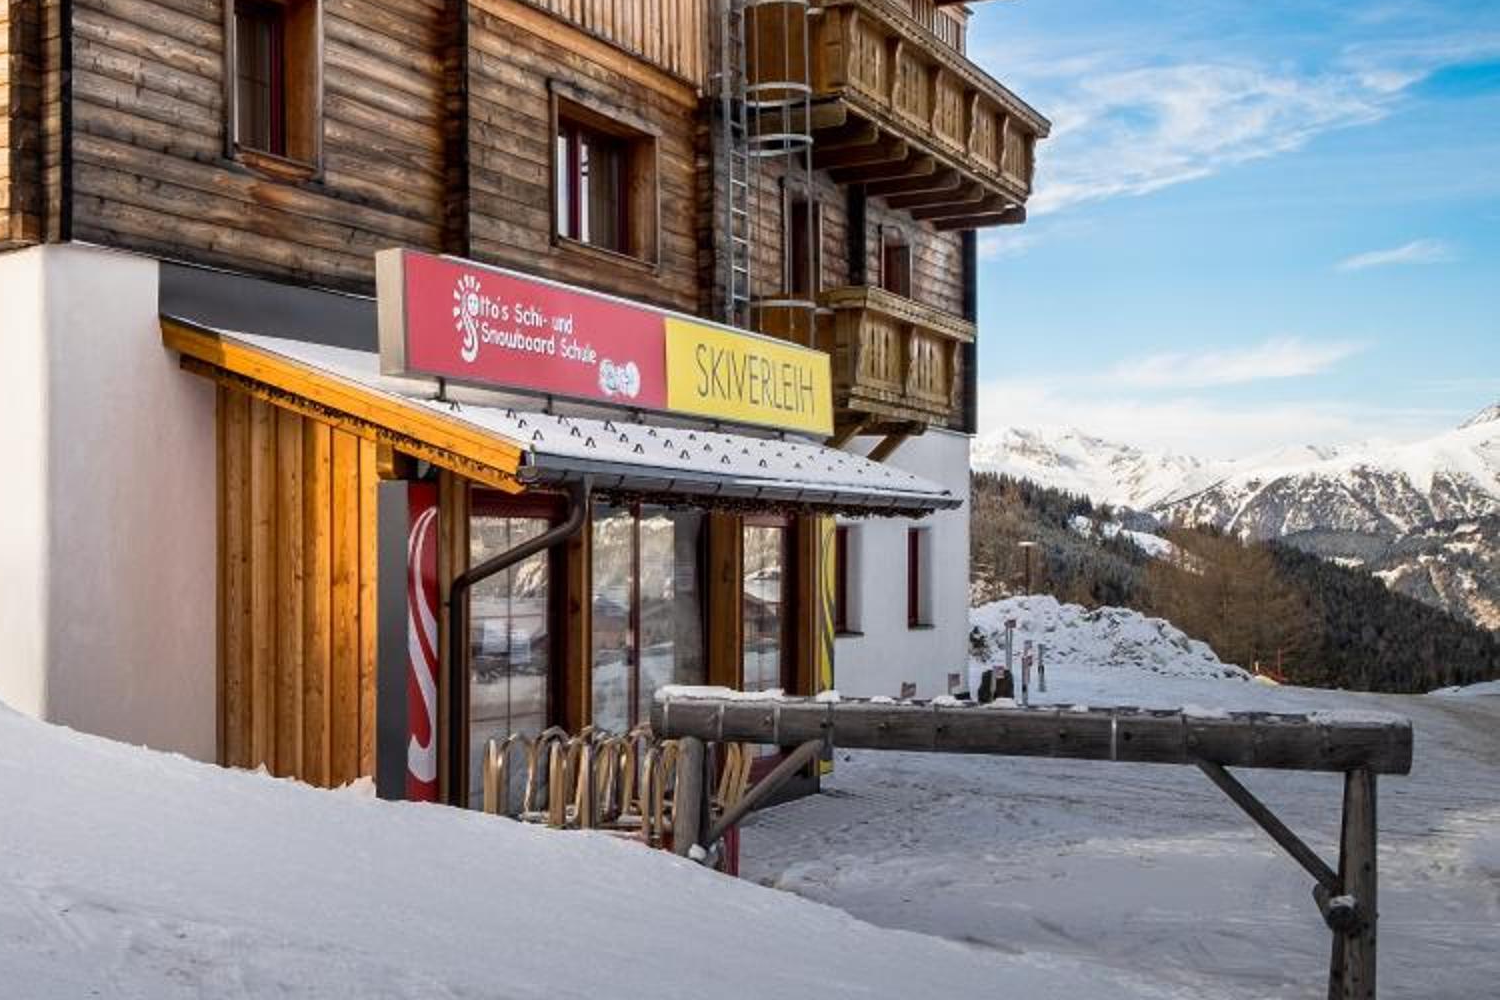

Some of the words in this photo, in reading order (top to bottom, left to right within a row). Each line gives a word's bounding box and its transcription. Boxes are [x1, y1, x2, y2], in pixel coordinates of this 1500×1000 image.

[515, 303, 548, 328] Schi-
[552, 313, 574, 335] und
[481, 321, 556, 355] Snowboard
[560, 337, 597, 363] Schule
[695, 342, 816, 417] SKIVERLEIH
